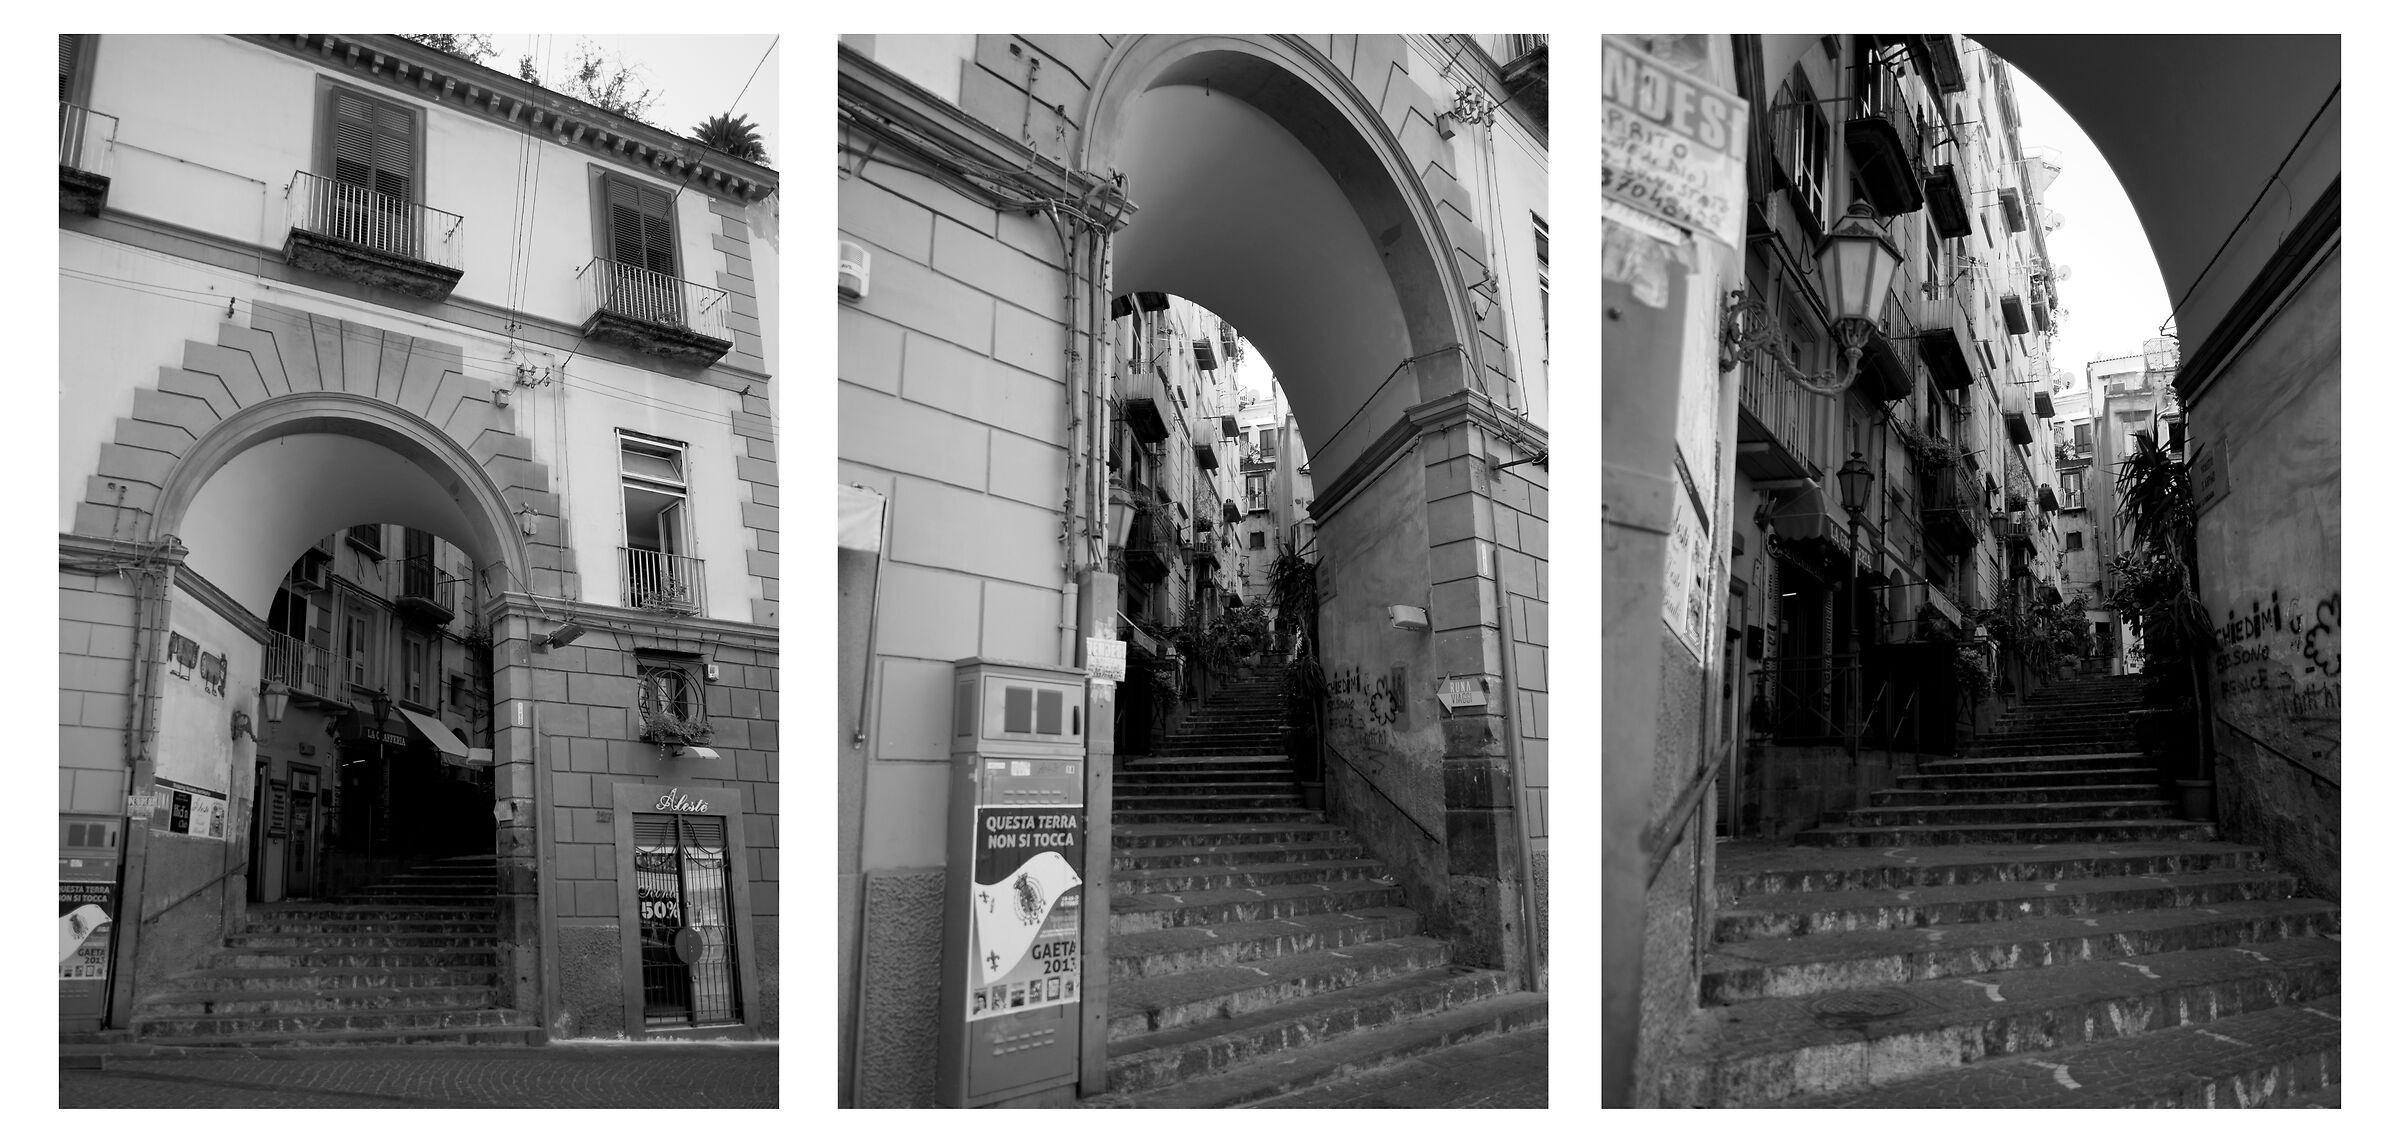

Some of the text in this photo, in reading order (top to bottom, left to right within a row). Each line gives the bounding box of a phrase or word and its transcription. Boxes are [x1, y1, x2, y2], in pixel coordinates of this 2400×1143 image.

[1450, 682, 1471, 693] RUNA
[986, 815, 1077, 832] QUESTA TERRA
[988, 832, 1075, 849] NON SI TOCCA
[86, 886, 110, 894] TERRA
[641, 901, 678, 919] 50%
[1032, 941, 1075, 960] GAETA
